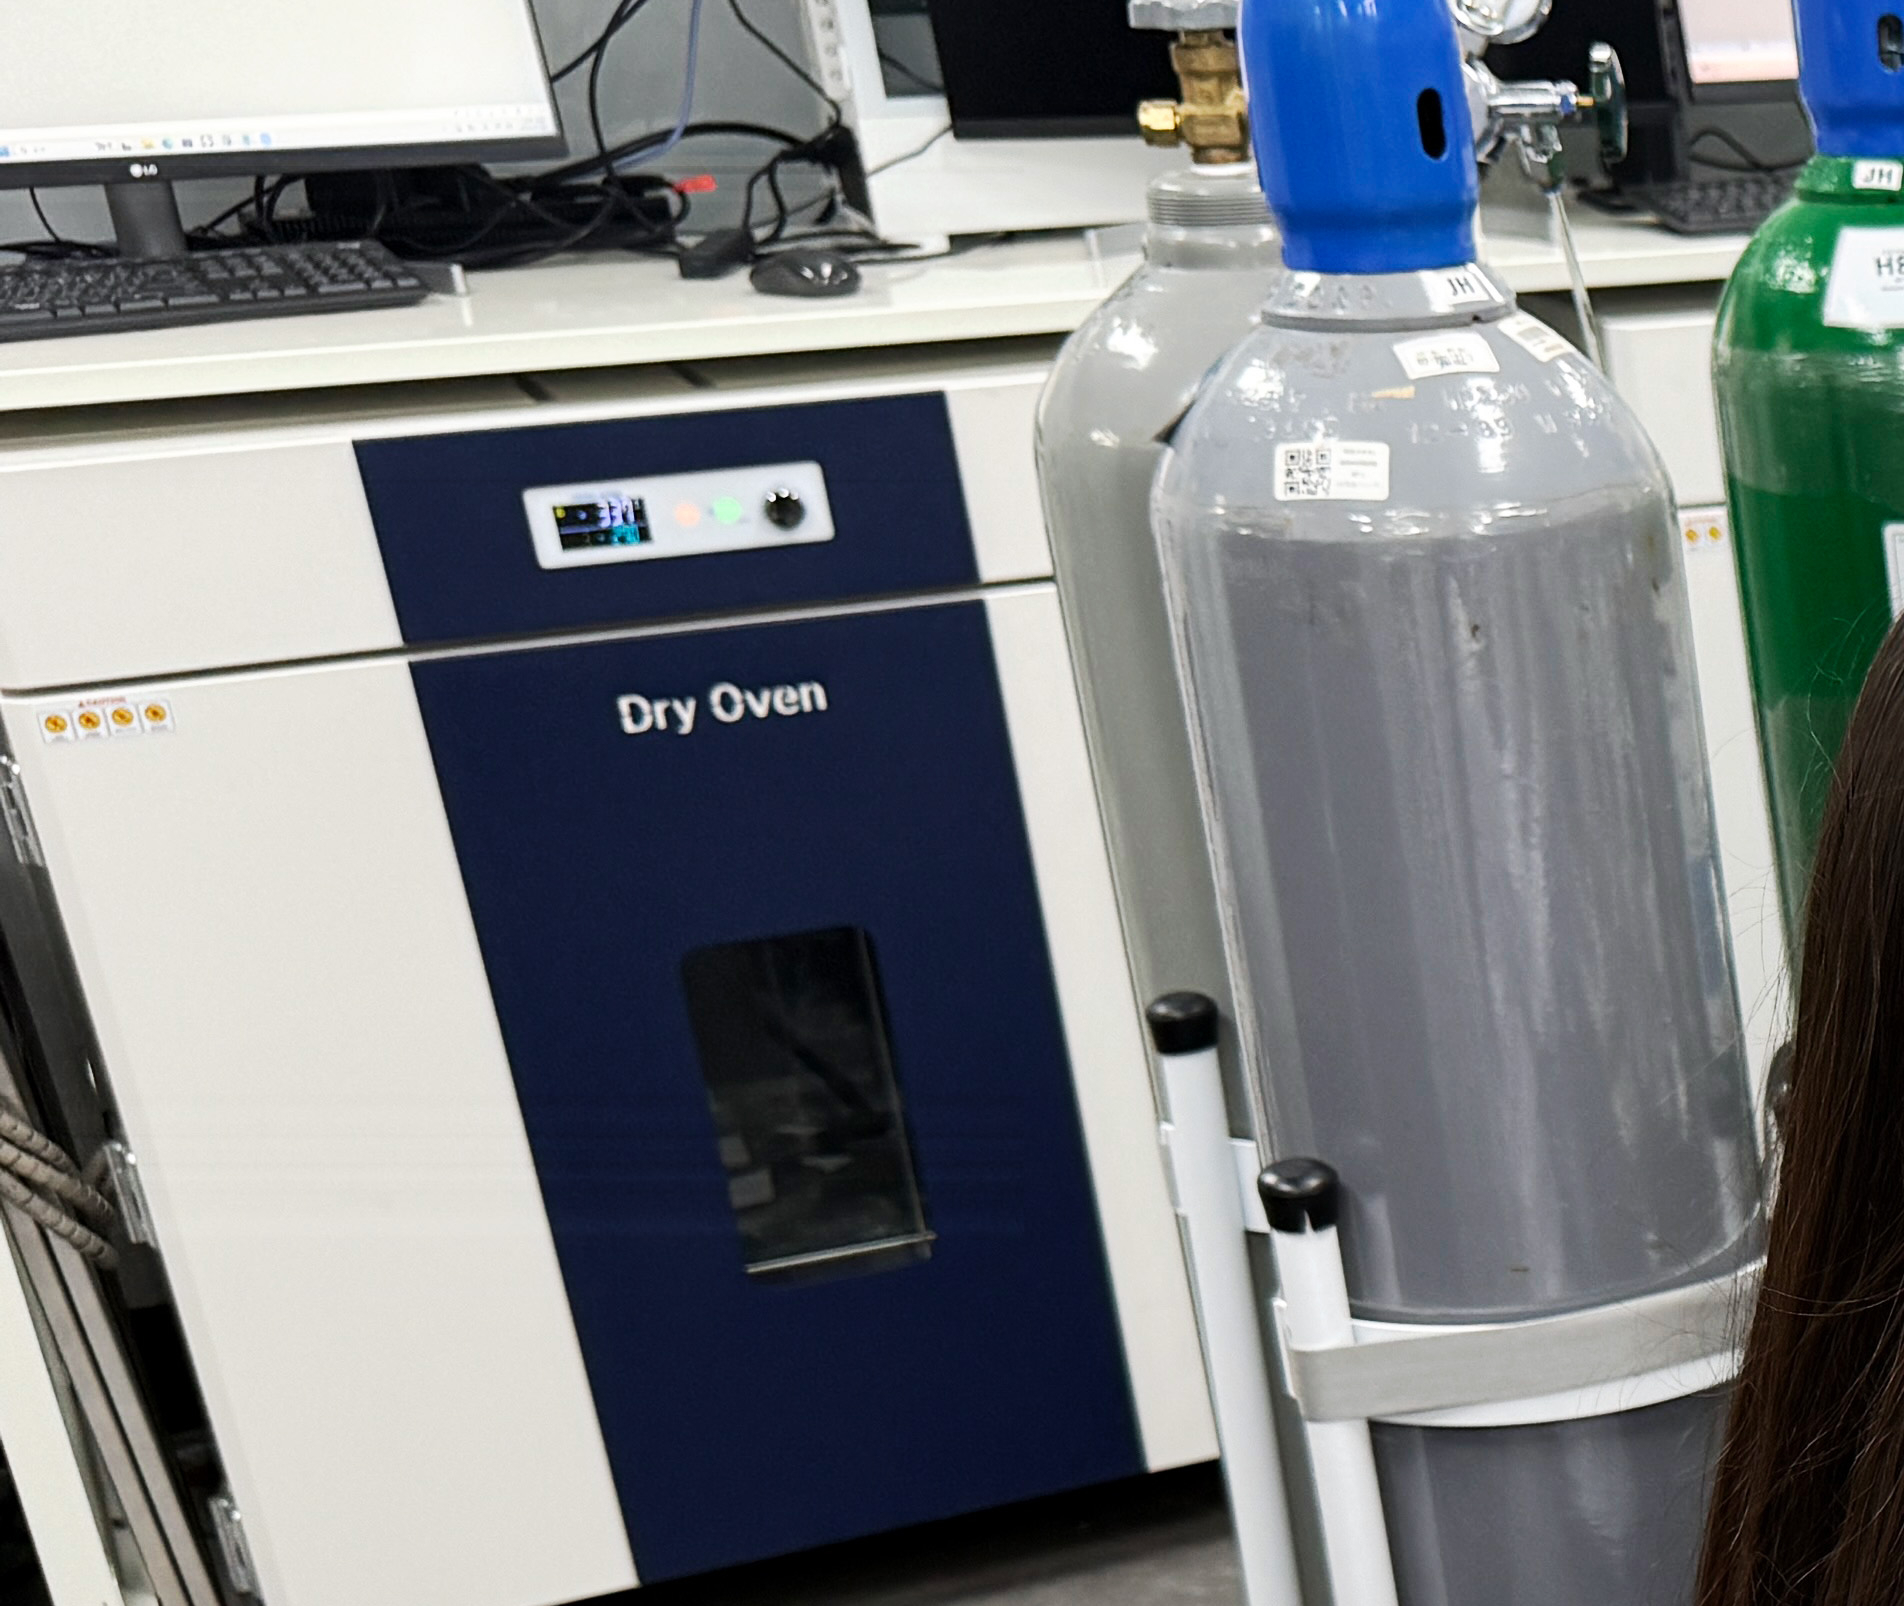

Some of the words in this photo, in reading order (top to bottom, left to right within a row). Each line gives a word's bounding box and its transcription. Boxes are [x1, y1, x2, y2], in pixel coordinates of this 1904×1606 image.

[143, 164, 158, 174] LG
[1862, 163, 1893, 184] JH
[1446, 277, 1475, 296] JH
[617, 693, 697, 735] Dry
[709, 681, 828, 723] Oven
